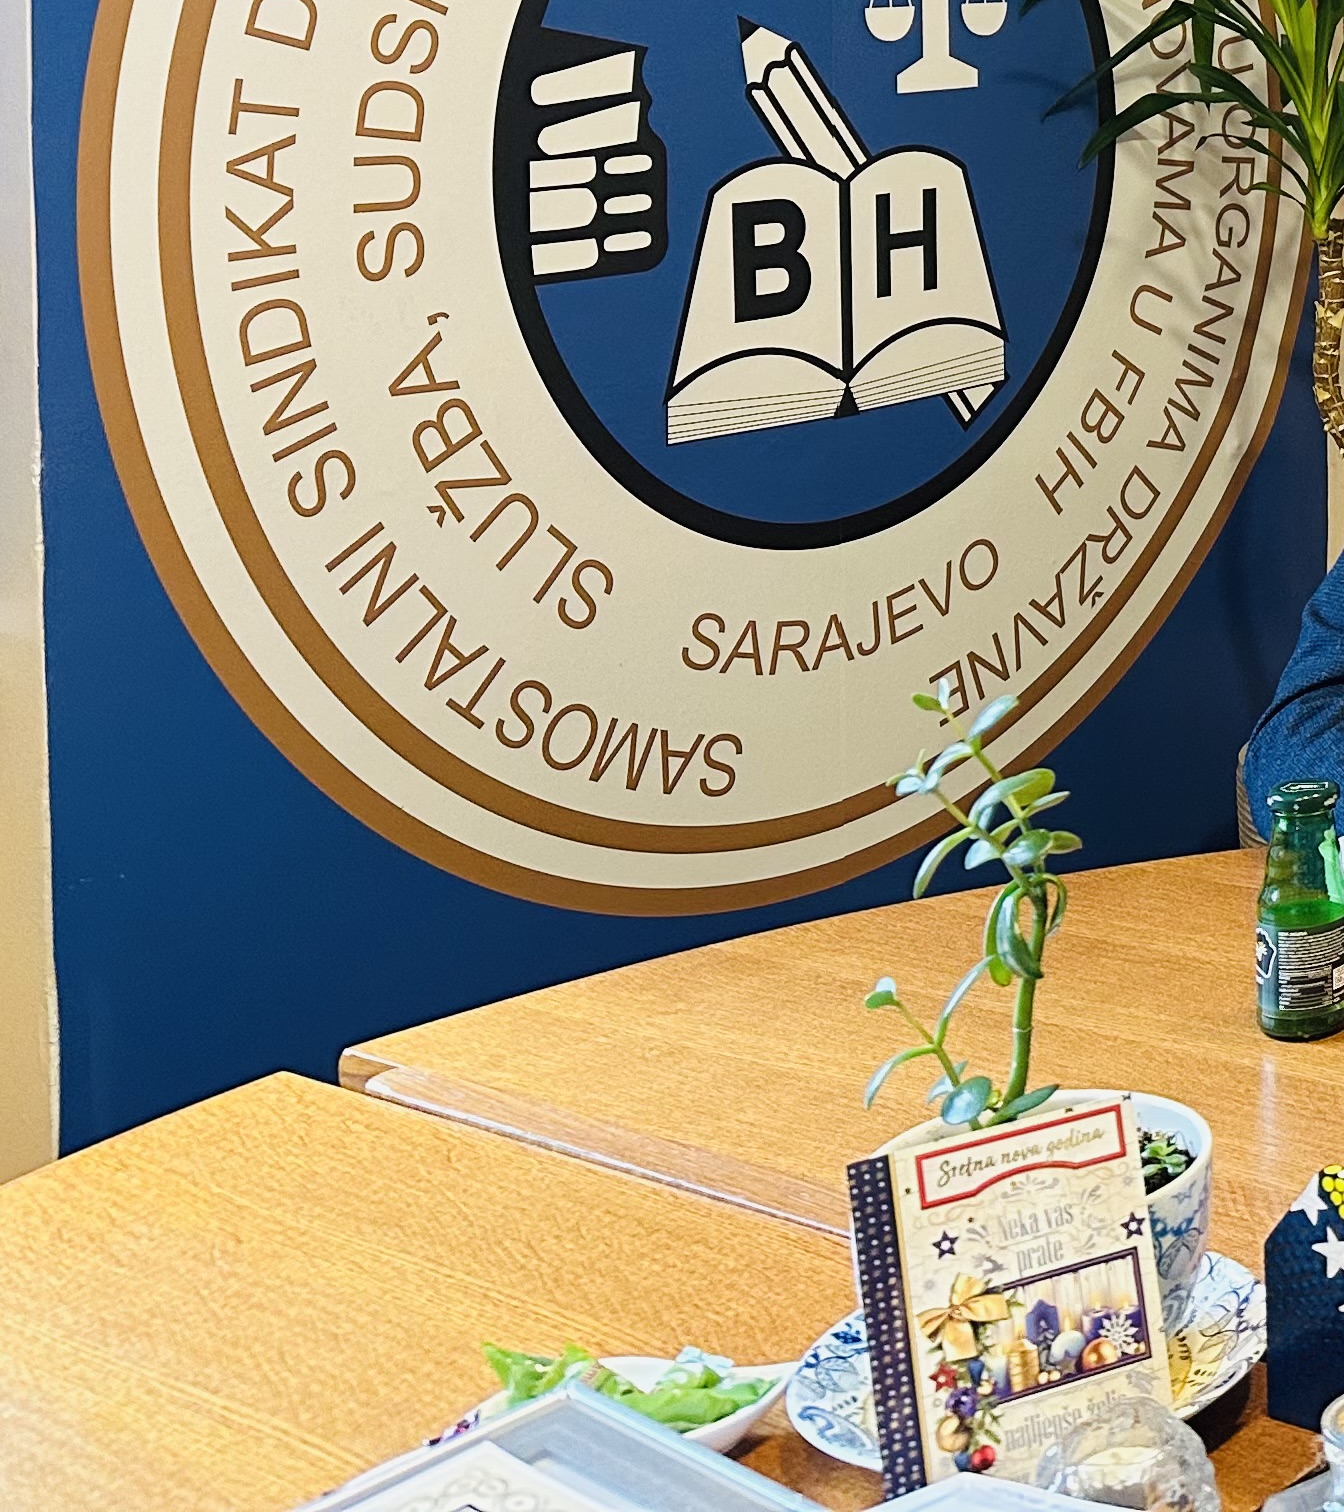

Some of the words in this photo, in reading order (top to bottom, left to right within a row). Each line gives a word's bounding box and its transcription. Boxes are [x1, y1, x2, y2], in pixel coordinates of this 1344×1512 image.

[224, 78, 356, 518] SINDIKAT
[731, 198, 812, 324] B
[875, 187, 938, 299] H
[1128, 284, 1174, 336] U
[1144, 102, 1256, 454] ORGANIMA
[387, 309, 614, 631] SLUŽBA,
[1034, 348, 1147, 516] FBIH
[325, 521, 743, 797] SAMOSTALNI
[681, 537, 1000, 677] SARAJEVO
[928, 464, 1163, 728] DRŽAVNE
[937, 1153, 997, 1188] Sretna
[1000, 1143, 1044, 1167] nova
[1046, 1127, 1104, 1160] godina
[1046, 1203, 1075, 1229] vas
[1015, 1236, 1065, 1278] prate
